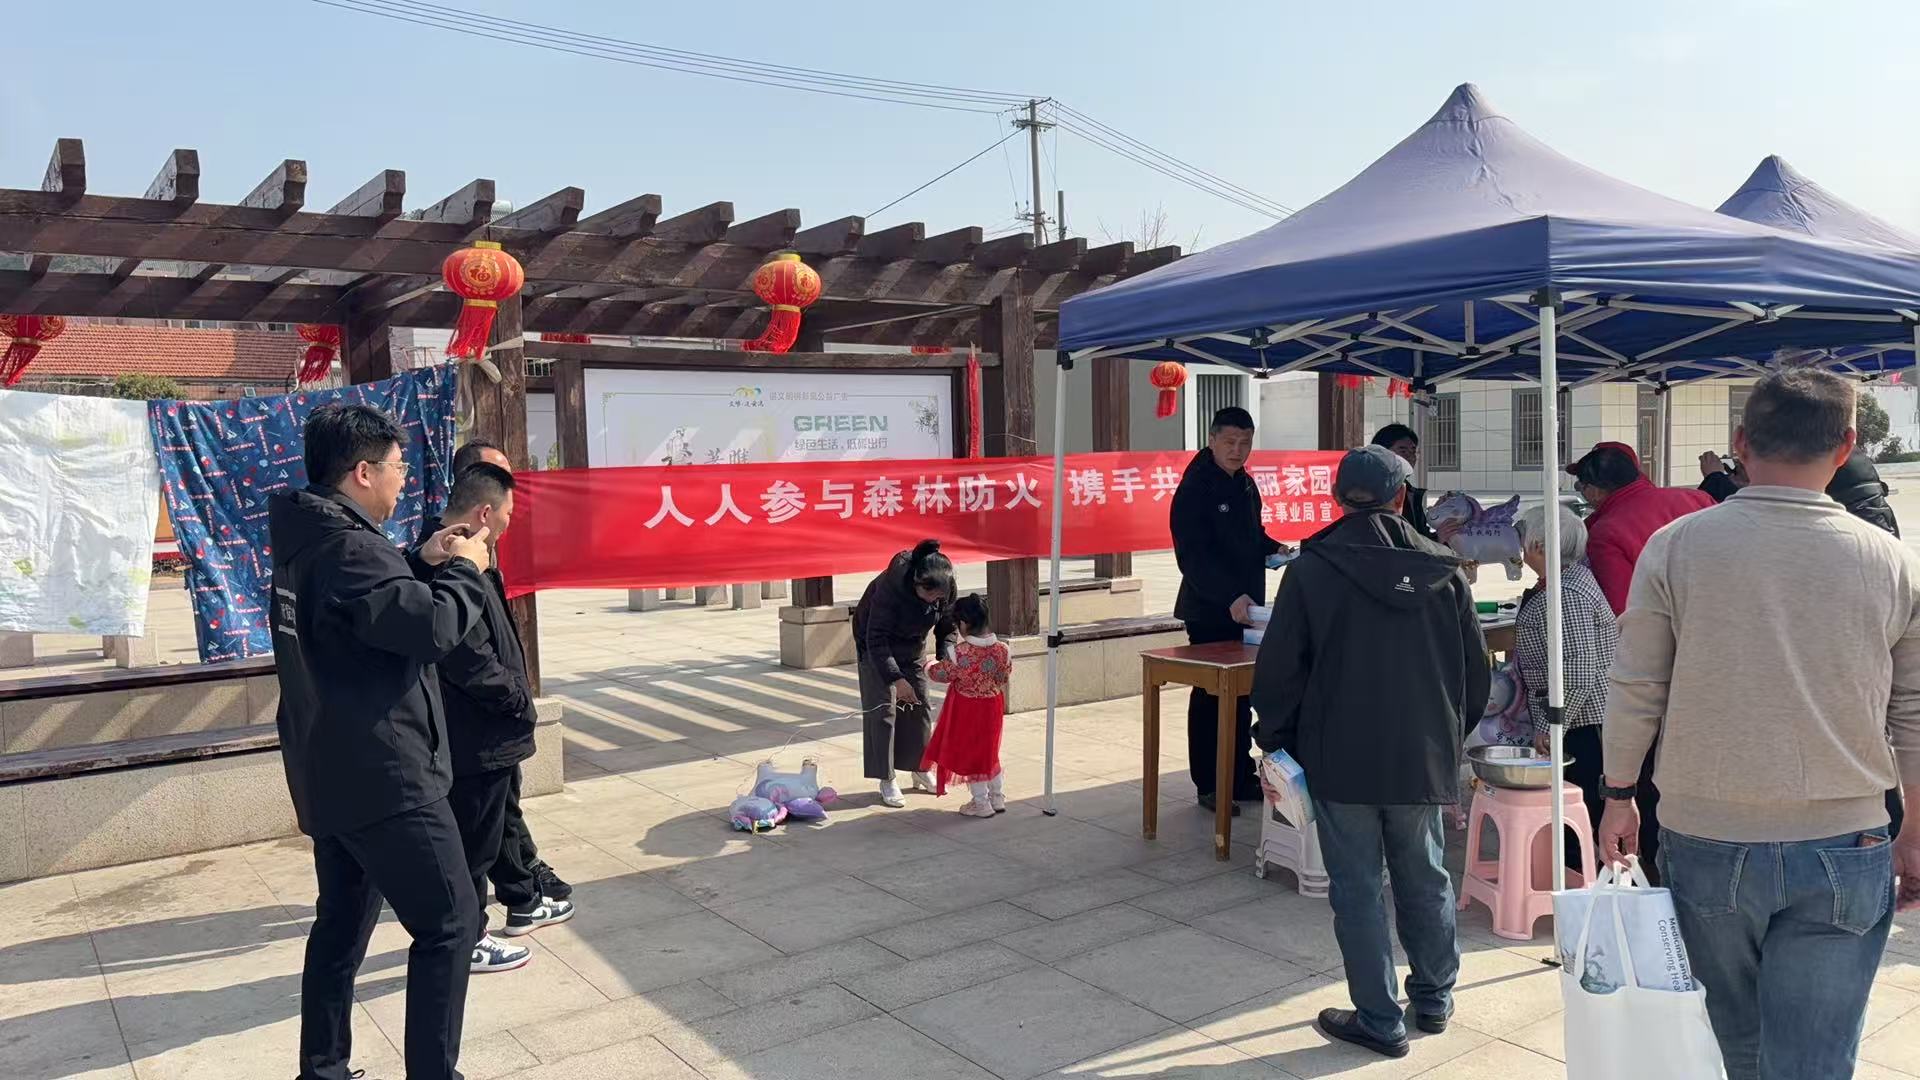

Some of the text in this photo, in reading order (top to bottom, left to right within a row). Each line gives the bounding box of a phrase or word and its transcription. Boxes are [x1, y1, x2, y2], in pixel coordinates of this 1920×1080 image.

[793, 415, 889, 432] GREEN
[643, 472, 1042, 529] 人人参与森林防火
[1319, 501, 1333, 522] 宣
[1657, 919, 1676, 972] Conserving
[1669, 917, 1684, 961] Medicinal
[1679, 963, 1690, 981] and
